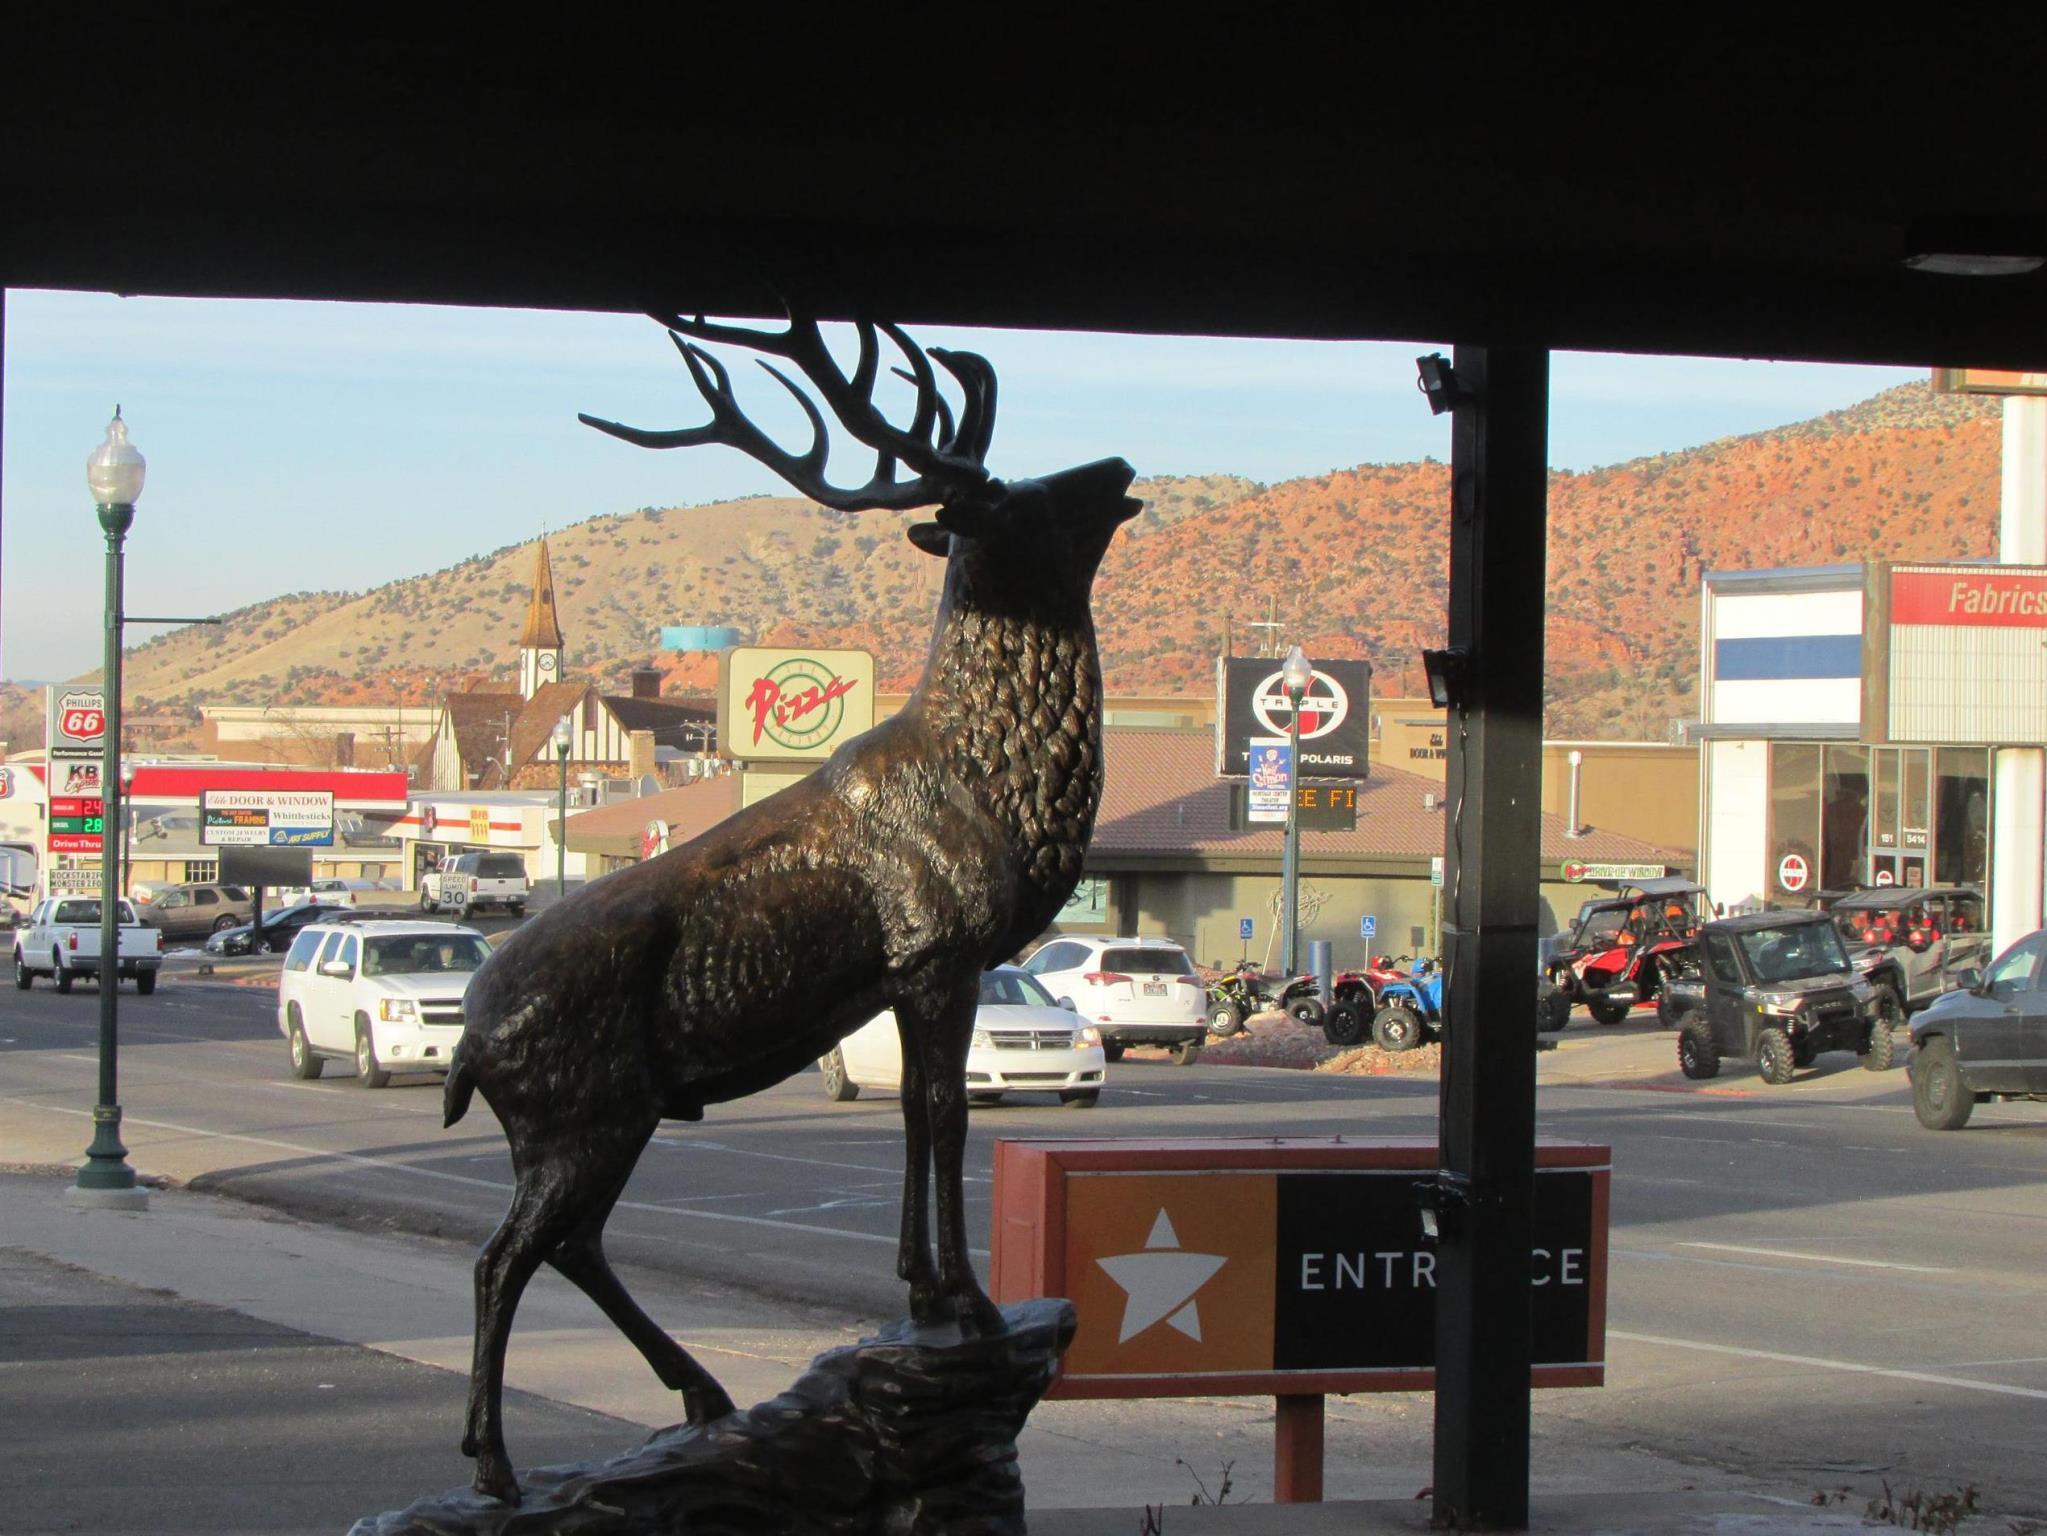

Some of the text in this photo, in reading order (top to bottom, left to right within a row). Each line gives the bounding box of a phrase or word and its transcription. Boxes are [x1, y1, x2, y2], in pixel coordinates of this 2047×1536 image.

[1948, 582, 2047, 615] Fabrics
[66, 699, 102, 708] PHILLIPS
[1260, 699, 1339, 709] TRPLE
[745, 675, 859, 747] Pizza
[68, 713, 100, 731] 66
[1300, 754, 1354, 765] POLARIS
[70, 765, 99, 782] KB
[230, 796, 264, 805] DOOR
[266, 797, 275, 806] &
[277, 796, 329, 806] WINDOW
[234, 815, 266, 825] FRAMING
[273, 811, 331, 821] Whittlesticks
[53, 840, 102, 848] Drive Thru
[443, 891, 465, 904] 30
[1301, 1249, 1584, 1290] ENTRCE
